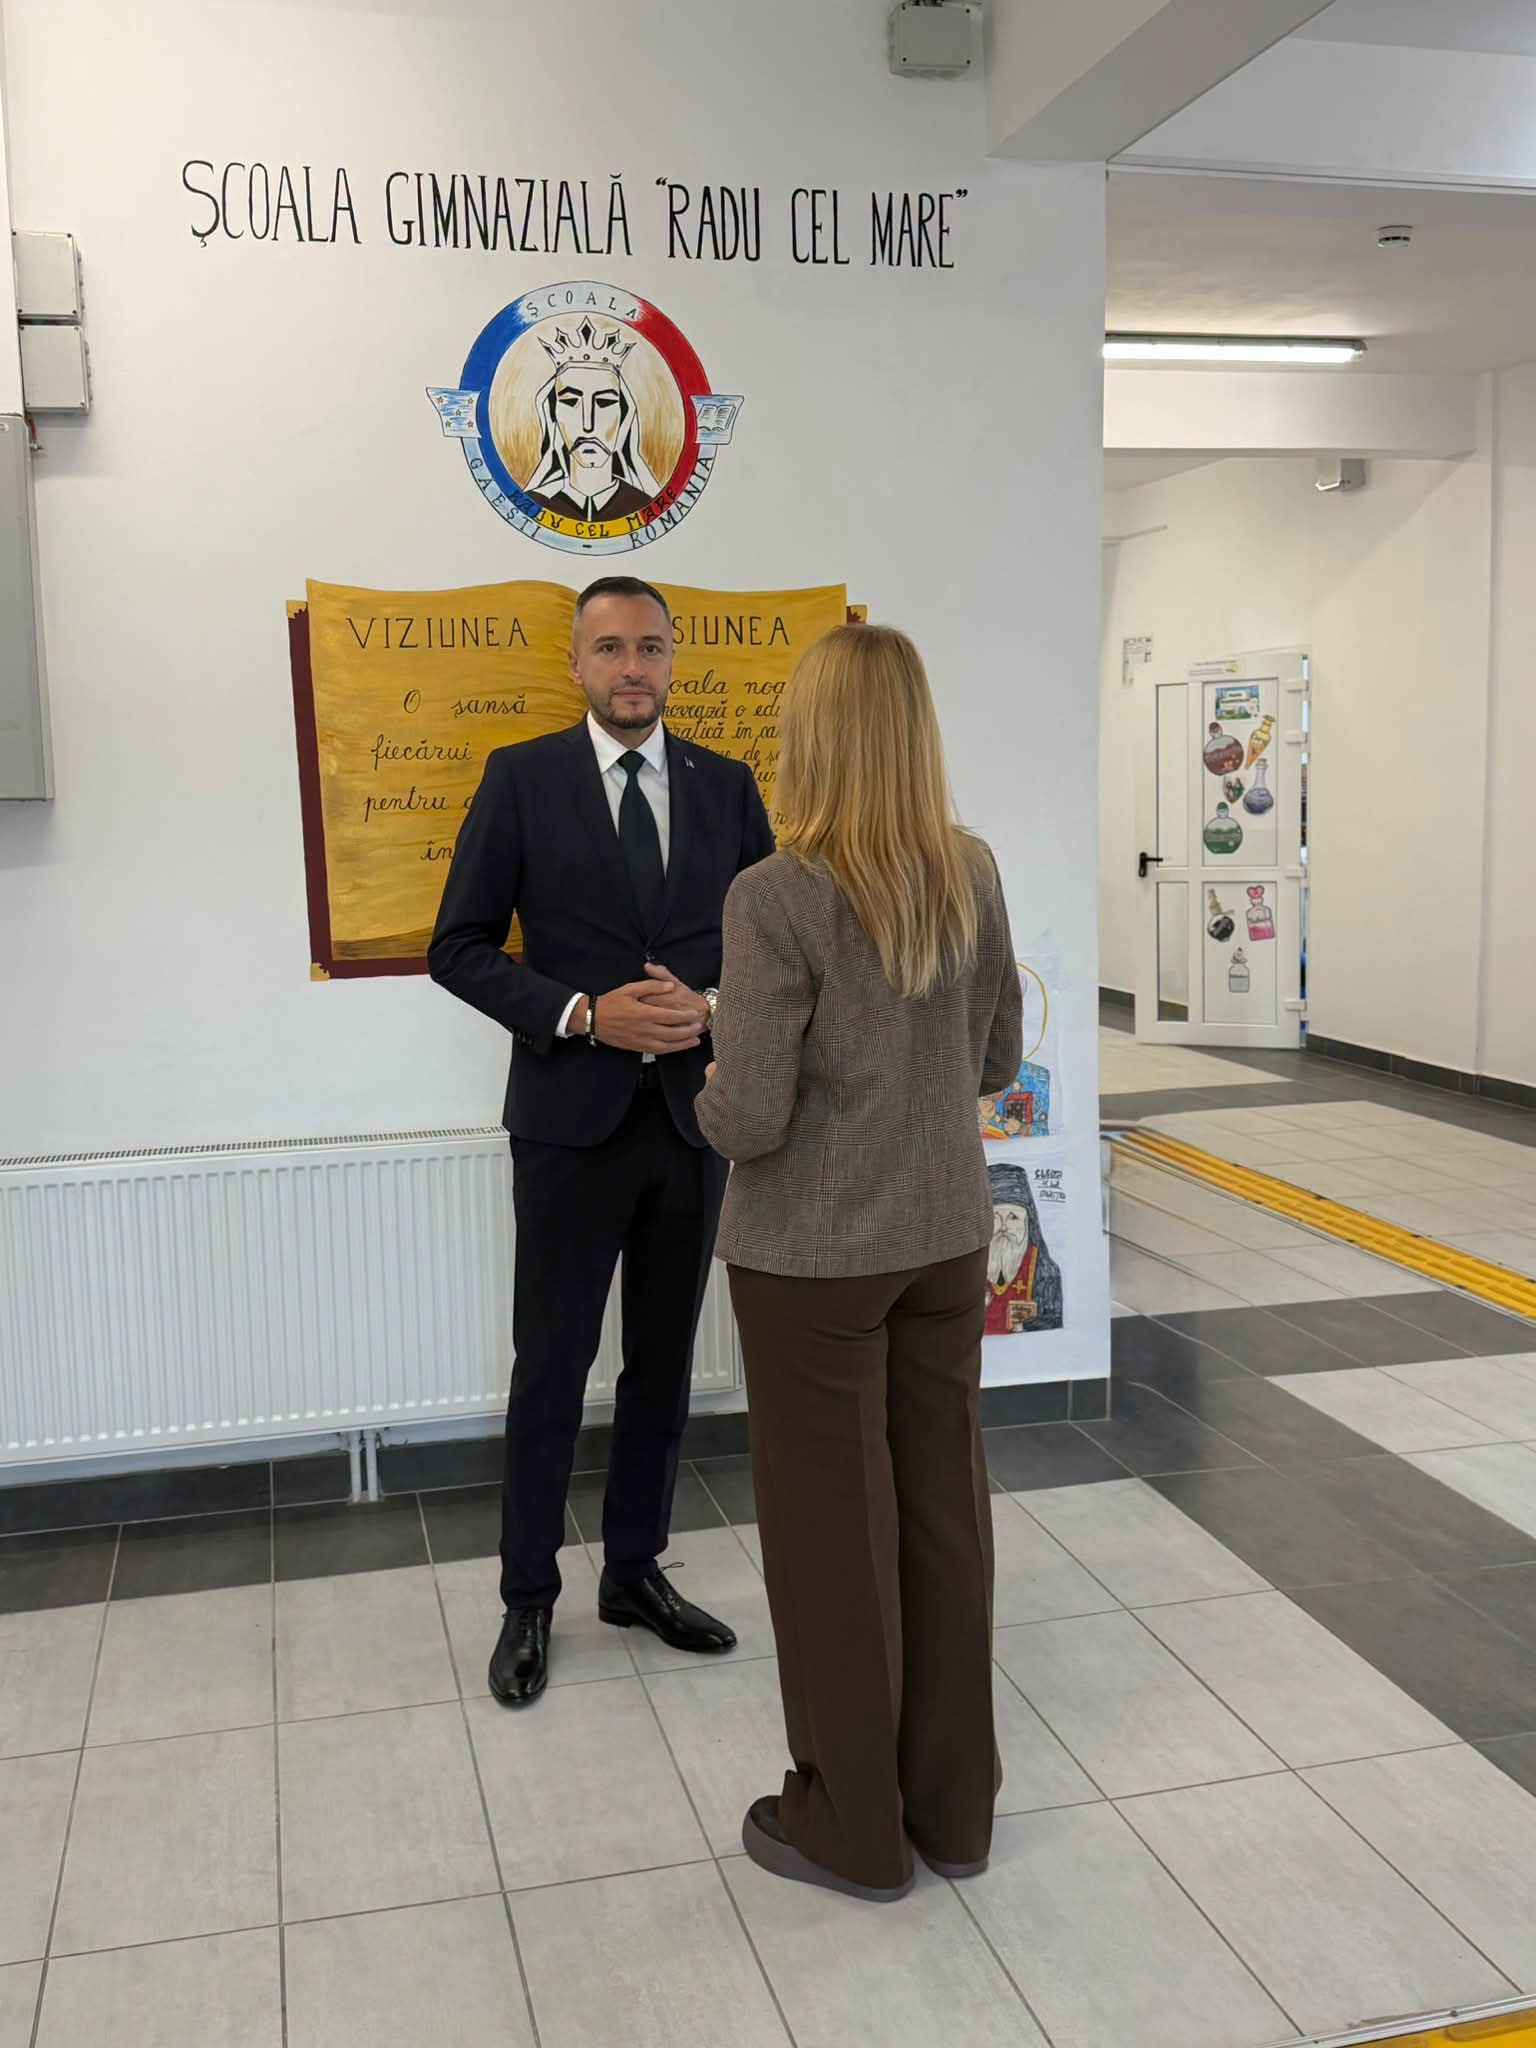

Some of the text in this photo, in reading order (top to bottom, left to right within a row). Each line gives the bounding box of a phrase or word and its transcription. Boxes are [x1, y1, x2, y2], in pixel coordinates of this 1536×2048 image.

[385, 172, 632, 256] GIMNAZIALĂ
[791, 188, 851, 265] CEL
[629, 456, 714, 550] ROMANIA
[575, 522, 609, 537] CEL
[346, 617, 529, 649] VIZIUNEA
[671, 615, 790, 646] SIUNEA
[669, 668, 729, 695] oala
[403, 689, 421, 714] O
[371, 733, 472, 772] fiecărui
[364, 786, 449, 823] pentru
